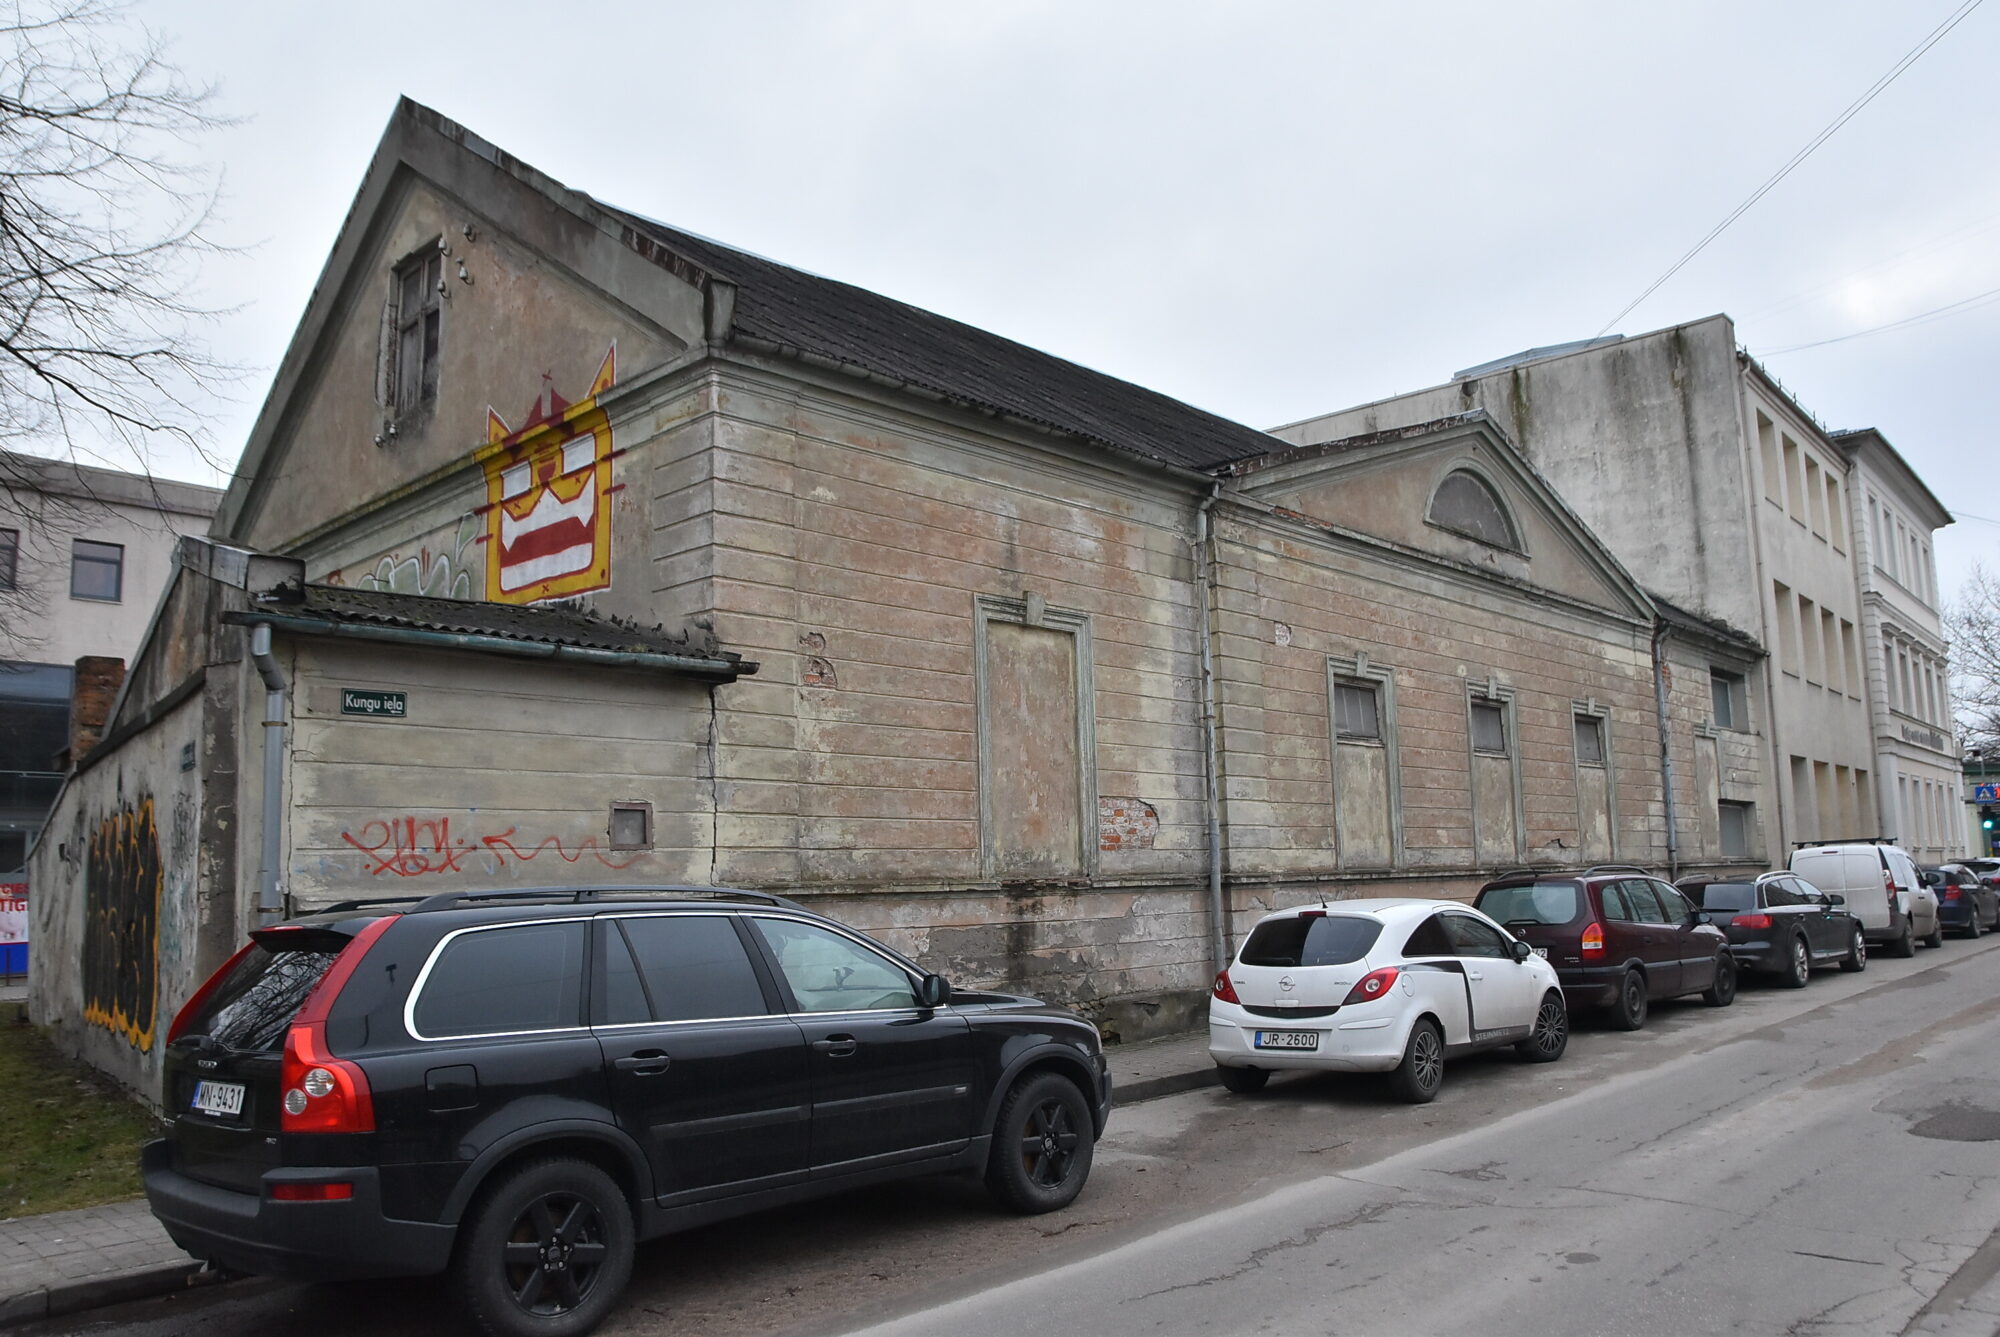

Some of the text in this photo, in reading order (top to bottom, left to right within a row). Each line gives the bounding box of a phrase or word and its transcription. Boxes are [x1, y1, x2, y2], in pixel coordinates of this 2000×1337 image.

[345, 693, 403, 712] Kungu iela
[198, 1083, 242, 1111] MN-9431
